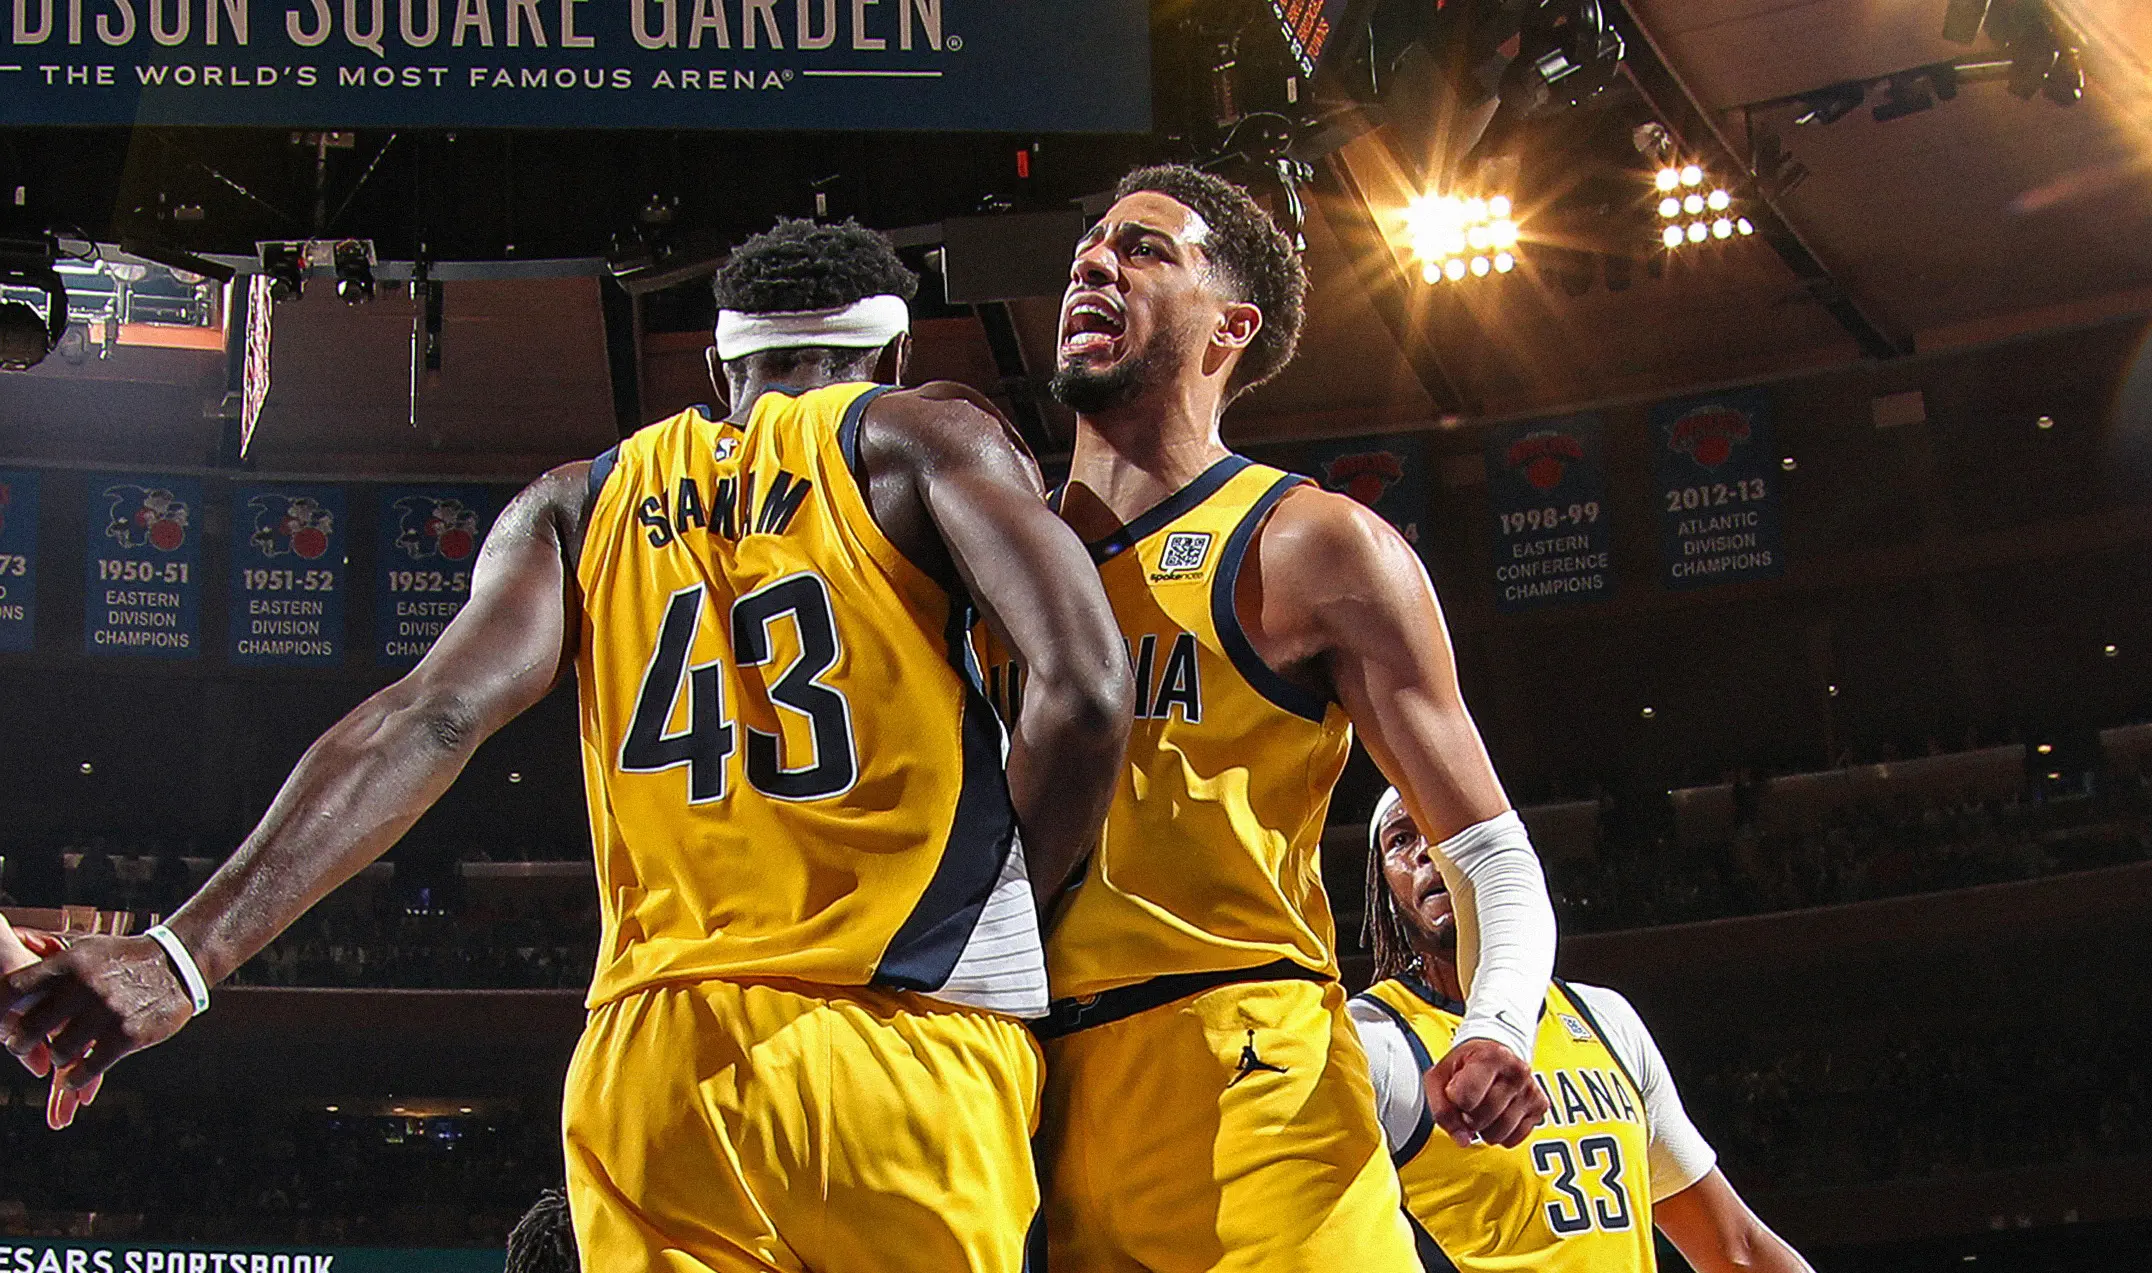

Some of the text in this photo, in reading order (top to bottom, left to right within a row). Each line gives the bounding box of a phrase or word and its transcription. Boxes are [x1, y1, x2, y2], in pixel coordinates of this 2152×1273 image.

[39, 65, 115, 86] THE
[135, 65, 318, 87] WORLD'S
[338, 66, 449, 88] MOST
[469, 67, 633, 89] FAMOUS
[1666, 478, 1766, 512] 2012-13
[1501, 502, 1600, 535] 1998-99
[1678, 511, 1759, 536] ATLANTIC
[1513, 535, 1590, 558] EASTERN
[1684, 533, 1757, 556] DIVISION
[98, 559, 189, 584] 1950-51
[1497, 552, 1608, 581] CONFERENCE
[1672, 550, 1772, 578] CHAMPIONS
[243, 569, 333, 592] 1951-52
[388, 571, 470, 592] 1952-5
[1505, 574, 1603, 601] CHAMPIONS
[105, 590, 180, 608] EASTERN
[249, 600, 323, 616] EASTERN
[397, 602, 462, 616] EASTER
[108, 610, 177, 628] DIVISION
[251, 620, 320, 636] DIVISION
[94, 629, 190, 648] CHAMPIONS
[238, 639, 332, 656] CHAMPIONS
[619, 570, 859, 806] 43
[1530, 1136, 1632, 1237] 33
[124, 1250, 334, 1273] SPORTSBOOK
